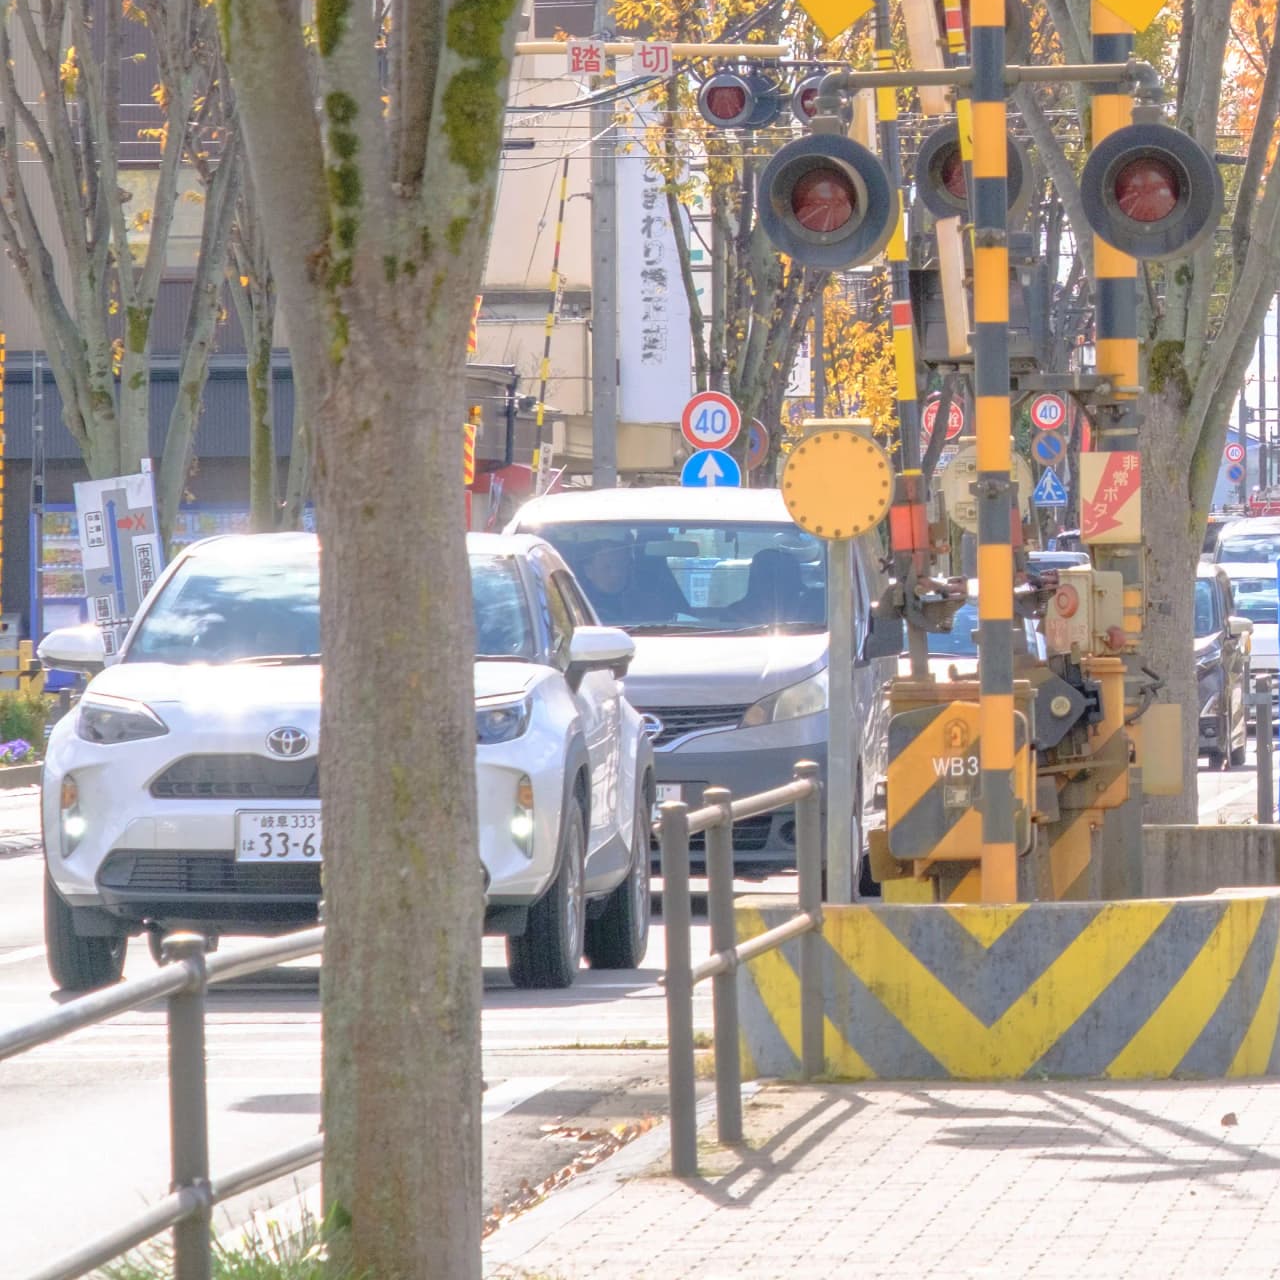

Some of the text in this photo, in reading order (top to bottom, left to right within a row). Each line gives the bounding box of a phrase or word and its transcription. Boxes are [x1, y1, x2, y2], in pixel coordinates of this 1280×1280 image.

[571, 45, 669, 73] 踏切
[695, 409, 727, 434] 40
[1038, 404, 1058, 420] 40
[932, 756, 978, 777] WB3
[291, 815, 316, 829] 333
[259, 832, 321, 857] 33-6
